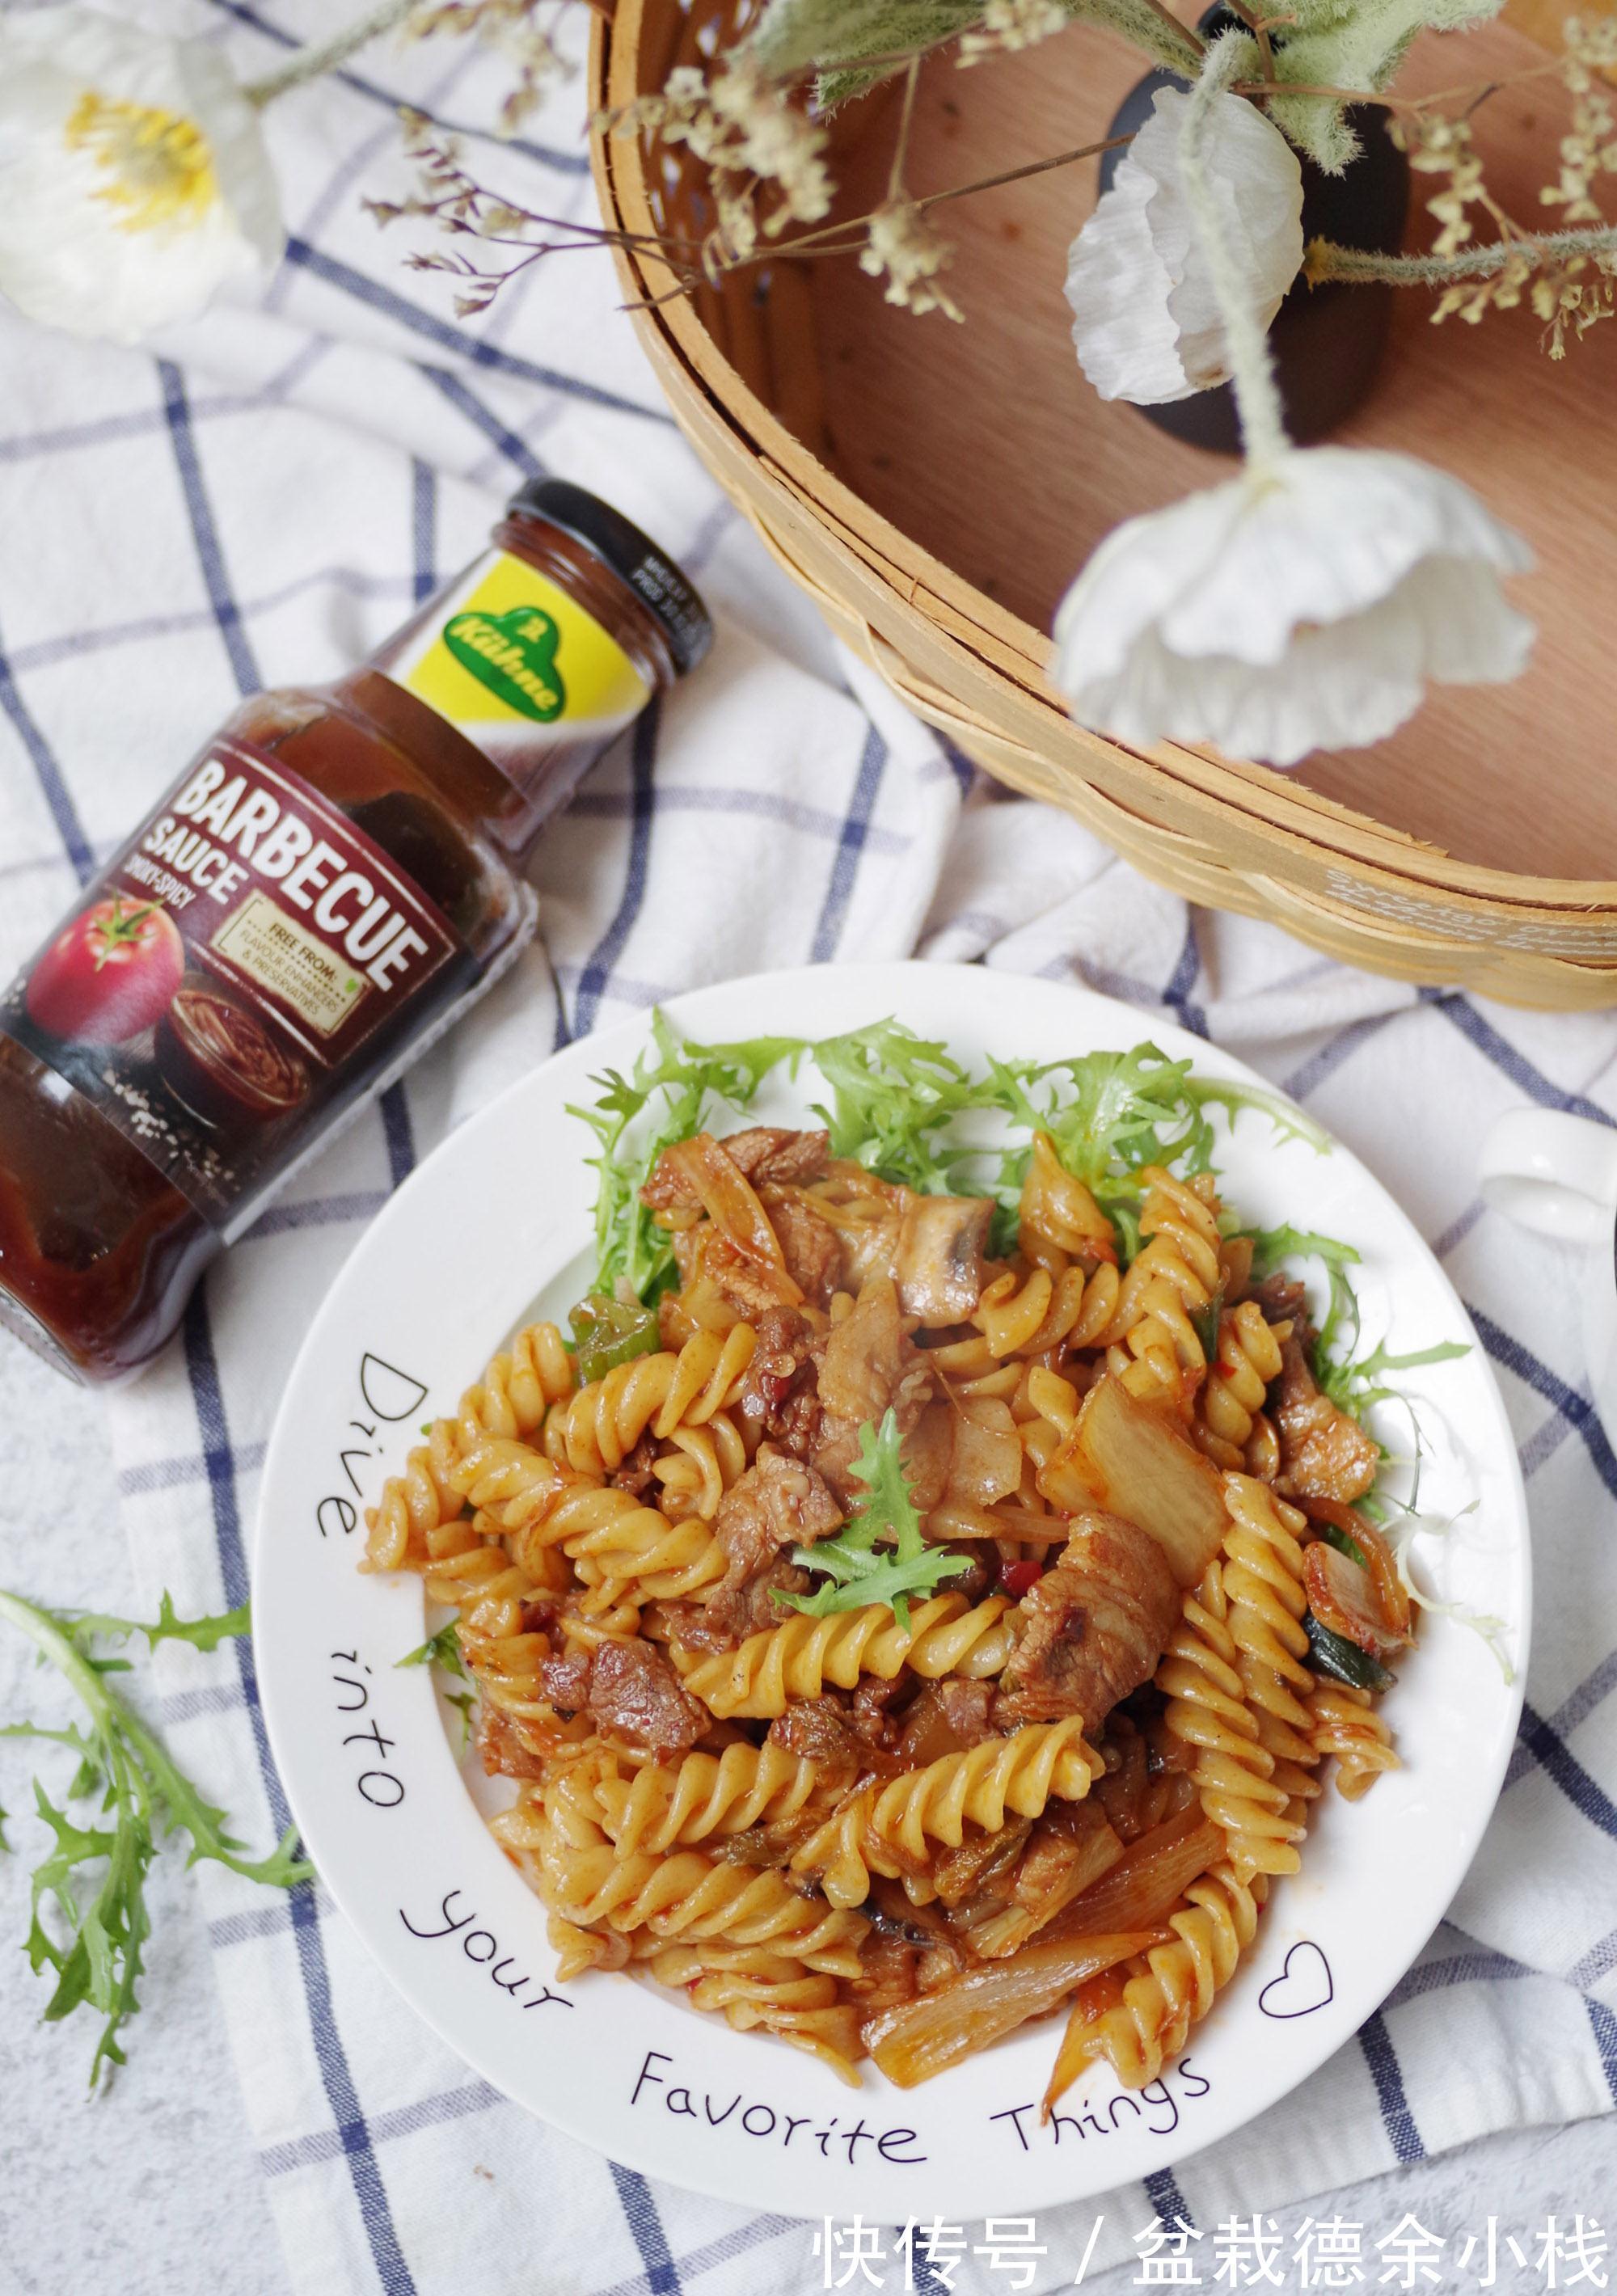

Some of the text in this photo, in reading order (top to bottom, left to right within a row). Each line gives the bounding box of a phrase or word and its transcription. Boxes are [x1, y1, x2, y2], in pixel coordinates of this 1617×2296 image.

[450, 617, 559, 711] Kühne
[143, 816, 250, 905] SAUCE
[172, 759, 429, 992] BARBECUE
[239, 930, 338, 1014] FLAVOUR ENHANCERS
[268, 922, 301, 948] FREE
[243, 948, 321, 1015] & PRESERVATIVES
[316, 1352, 1210, 2164] Dive into your Favorite Things
